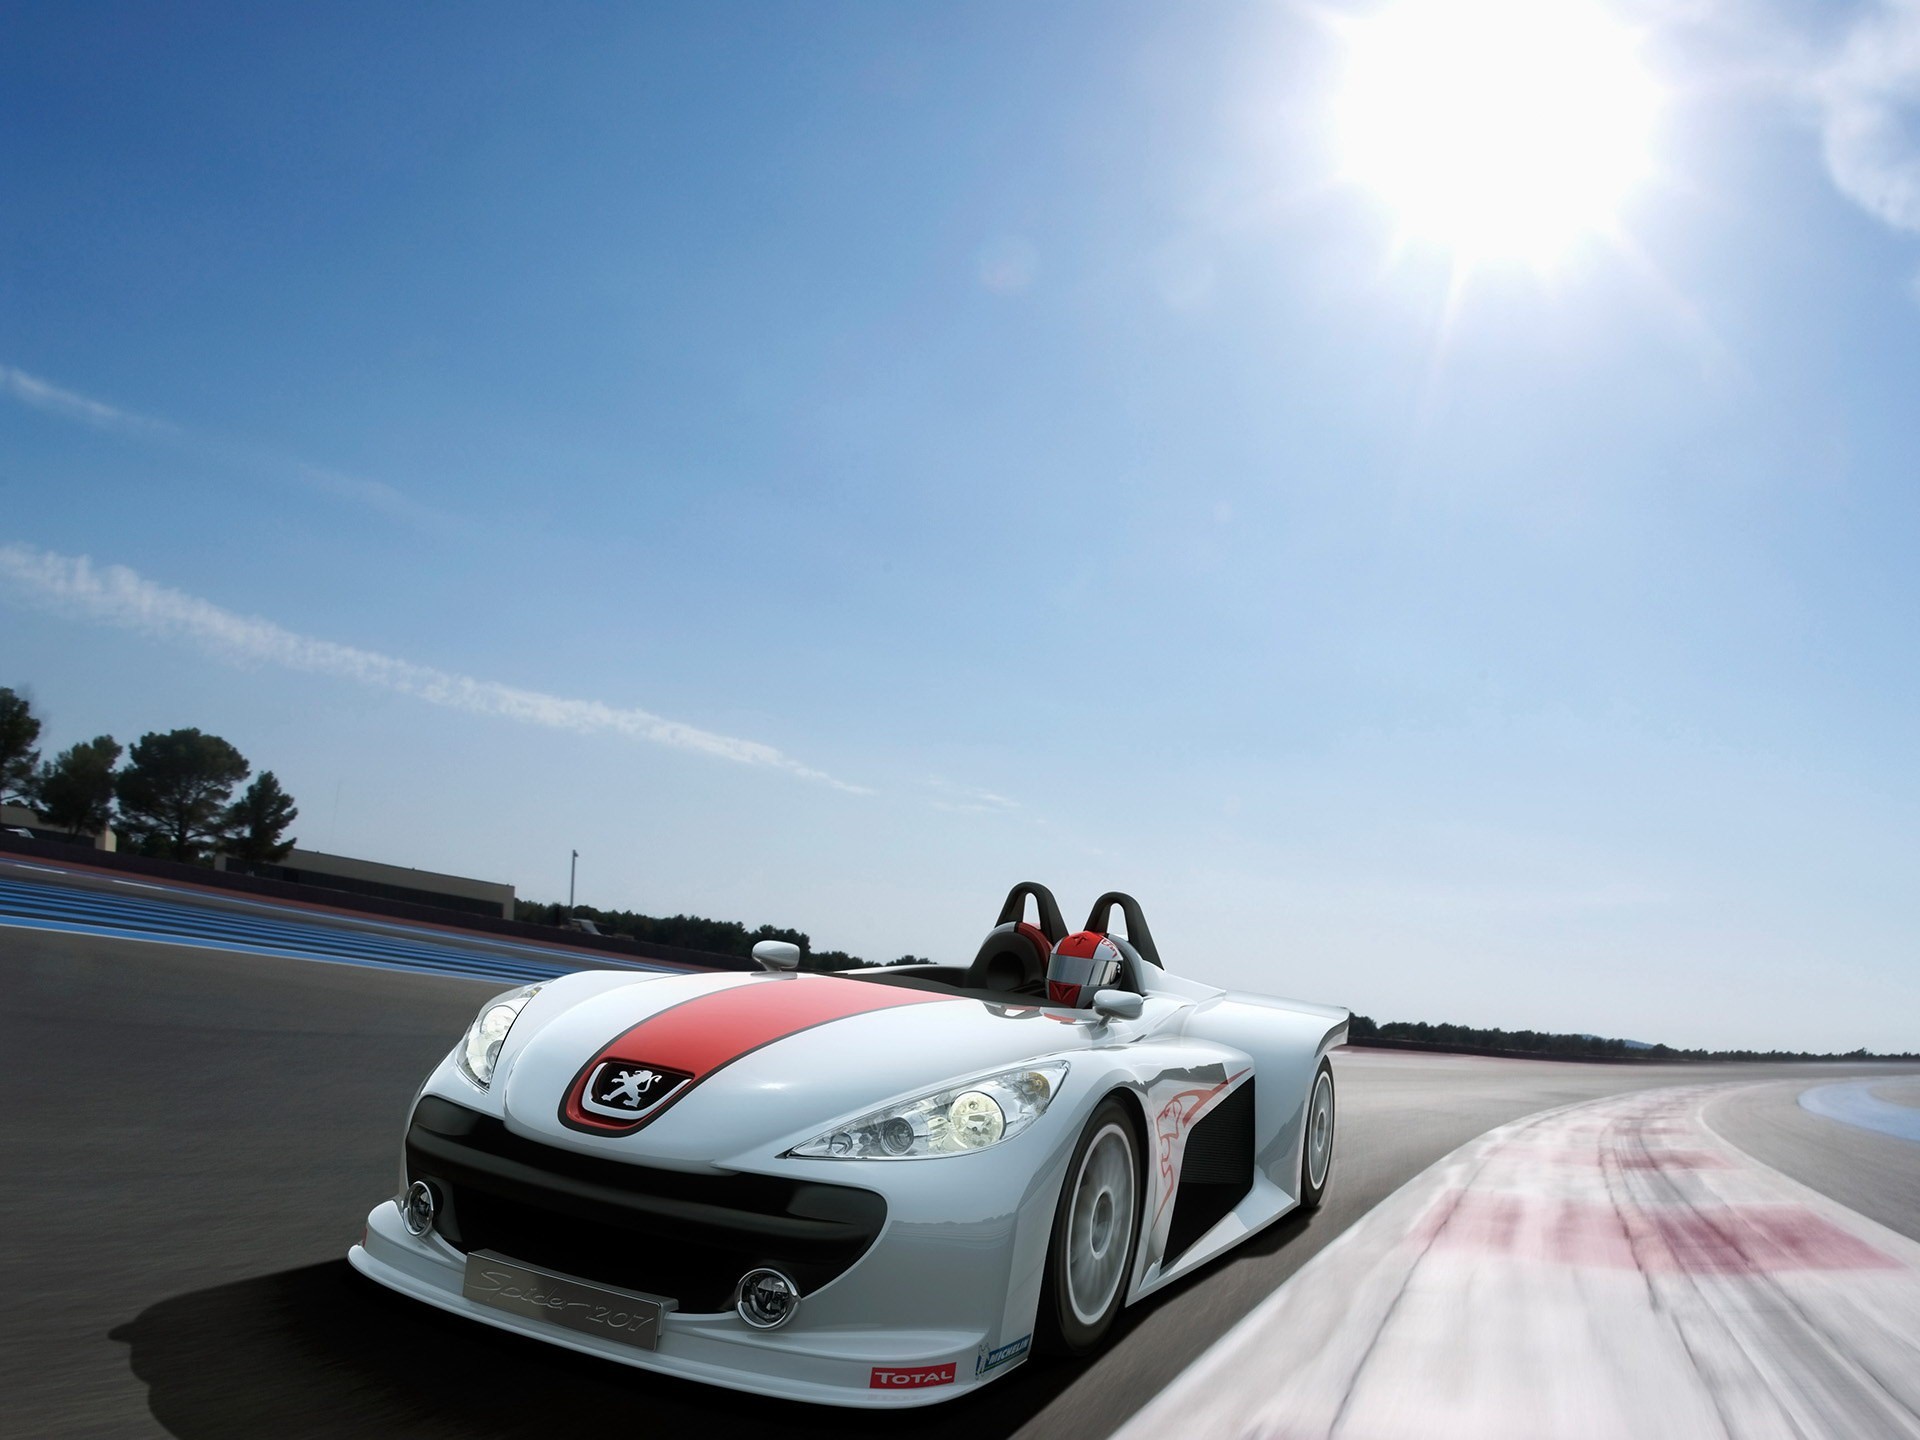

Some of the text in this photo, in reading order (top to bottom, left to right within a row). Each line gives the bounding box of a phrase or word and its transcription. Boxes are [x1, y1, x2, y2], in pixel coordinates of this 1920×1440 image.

[465, 1271, 654, 1332] Spider 207
[988, 1338, 1030, 1364] MICHELIN
[875, 1371, 952, 1384] TOTAL
